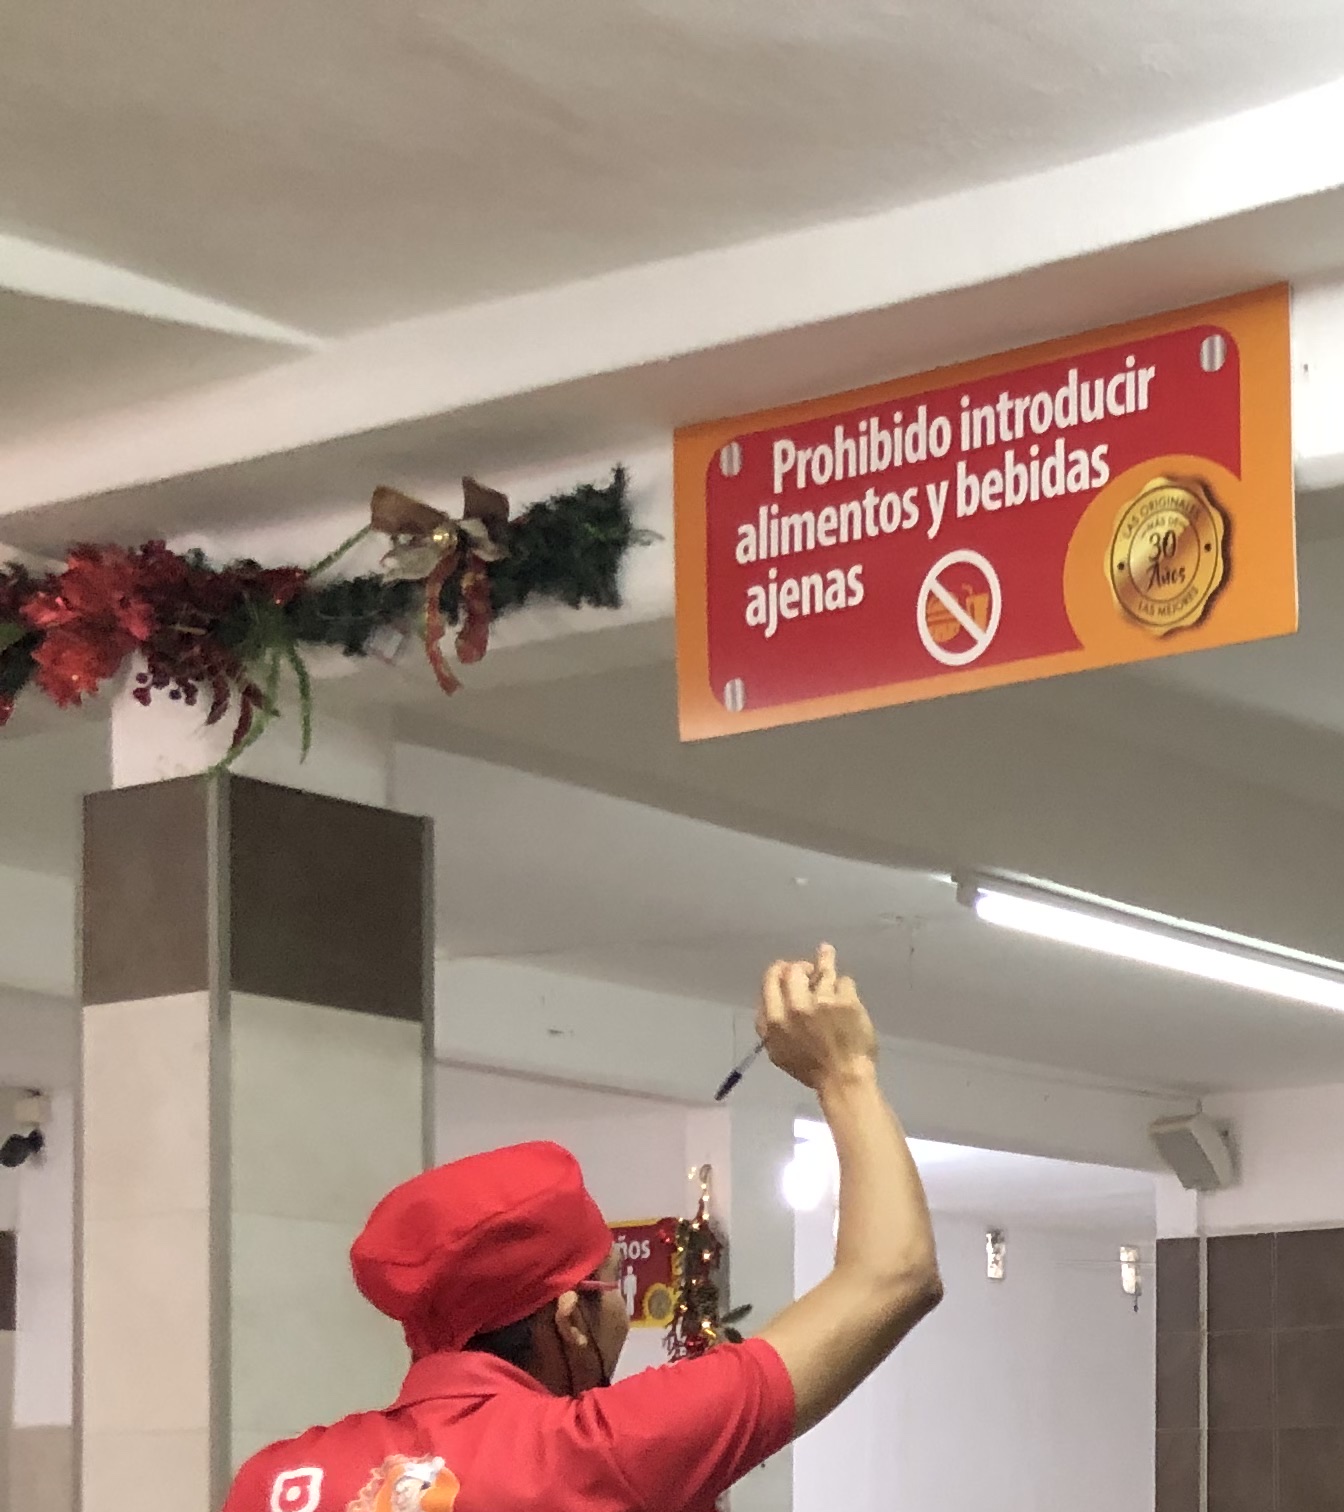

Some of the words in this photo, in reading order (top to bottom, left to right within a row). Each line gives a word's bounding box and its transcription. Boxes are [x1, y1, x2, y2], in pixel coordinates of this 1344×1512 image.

[773, 402, 953, 494] Prohibido
[961, 355, 1156, 452] introducir
[734, 485, 919, 566] alimentos
[926, 480, 949, 540] y
[957, 438, 1111, 519] bebidas
[1150, 530, 1177, 561] 30
[745, 561, 865, 639] ajenas
[1138, 600, 1155, 617] LAS
